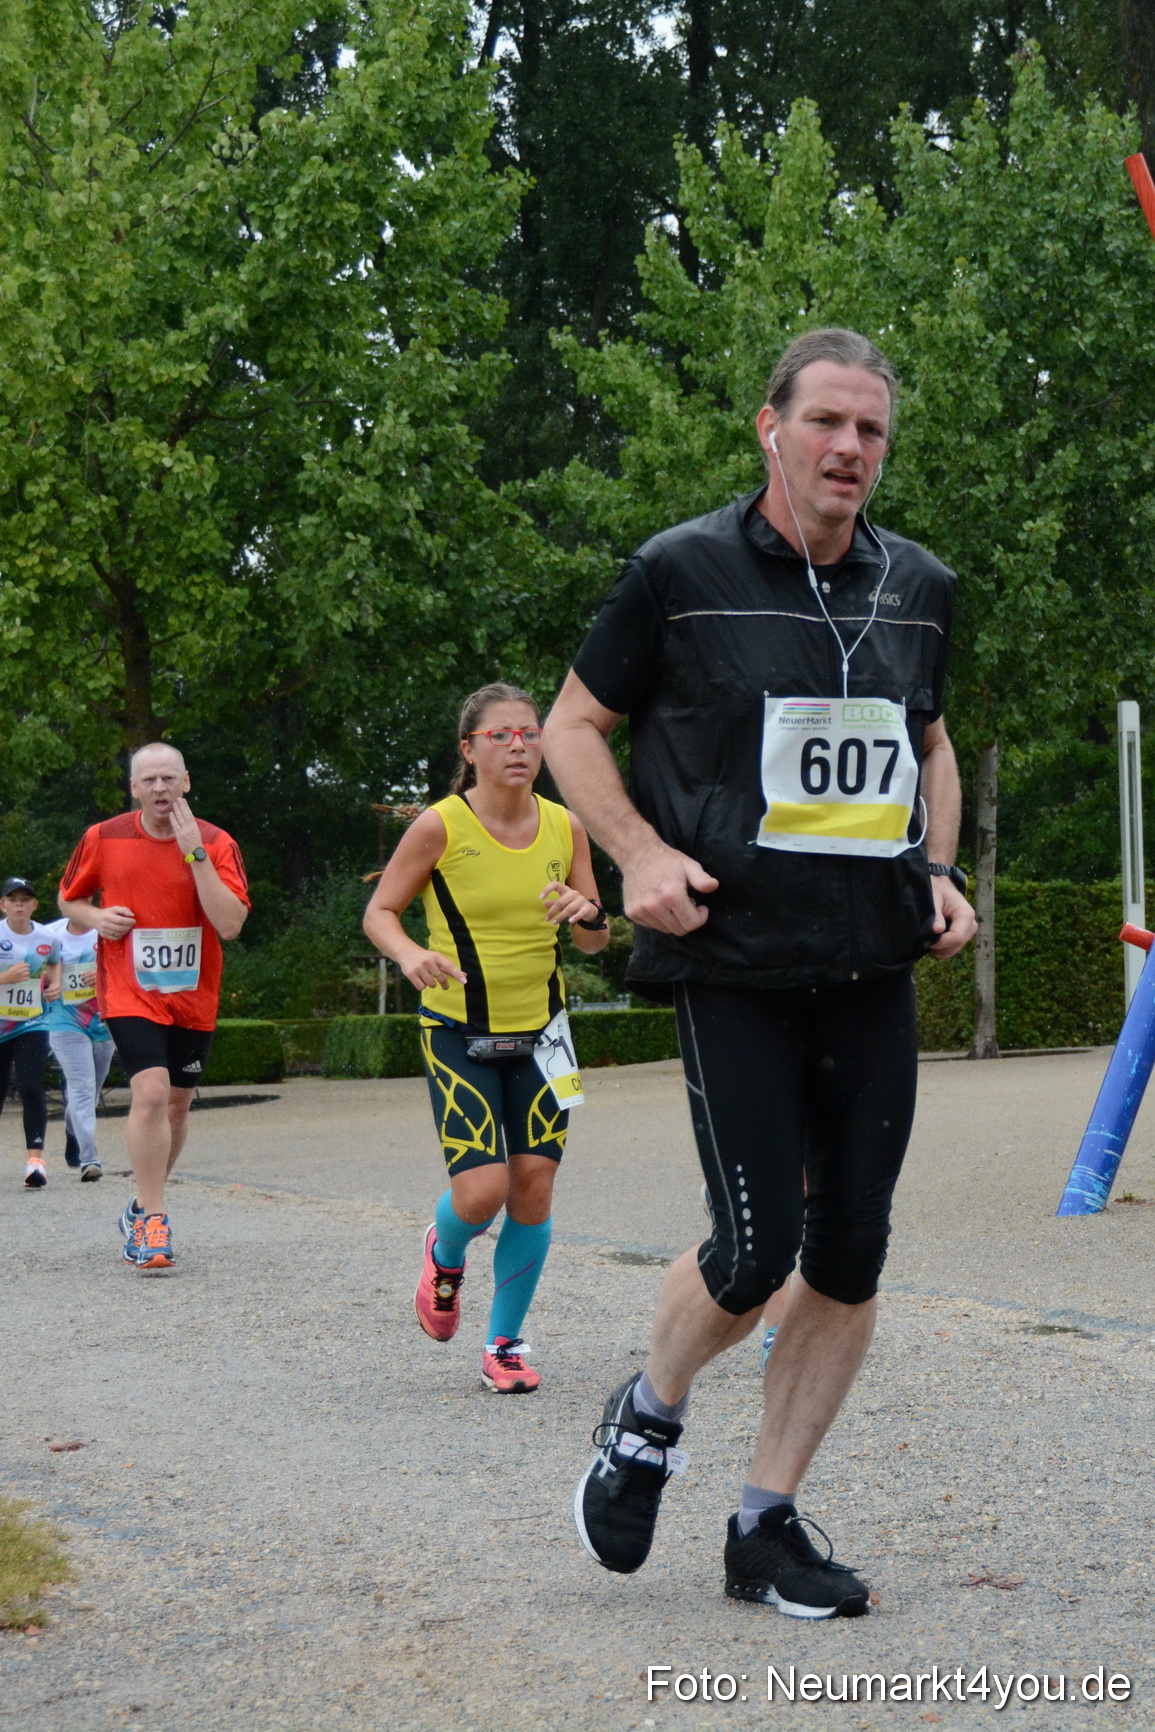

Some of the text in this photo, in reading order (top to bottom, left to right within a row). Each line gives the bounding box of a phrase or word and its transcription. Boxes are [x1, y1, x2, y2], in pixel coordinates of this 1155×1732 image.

[778, 716, 832, 726] NeuerMarkt
[800, 737, 900, 796] 607
[142, 943, 196, 969] 3010
[6, 988, 33, 1006] 104
